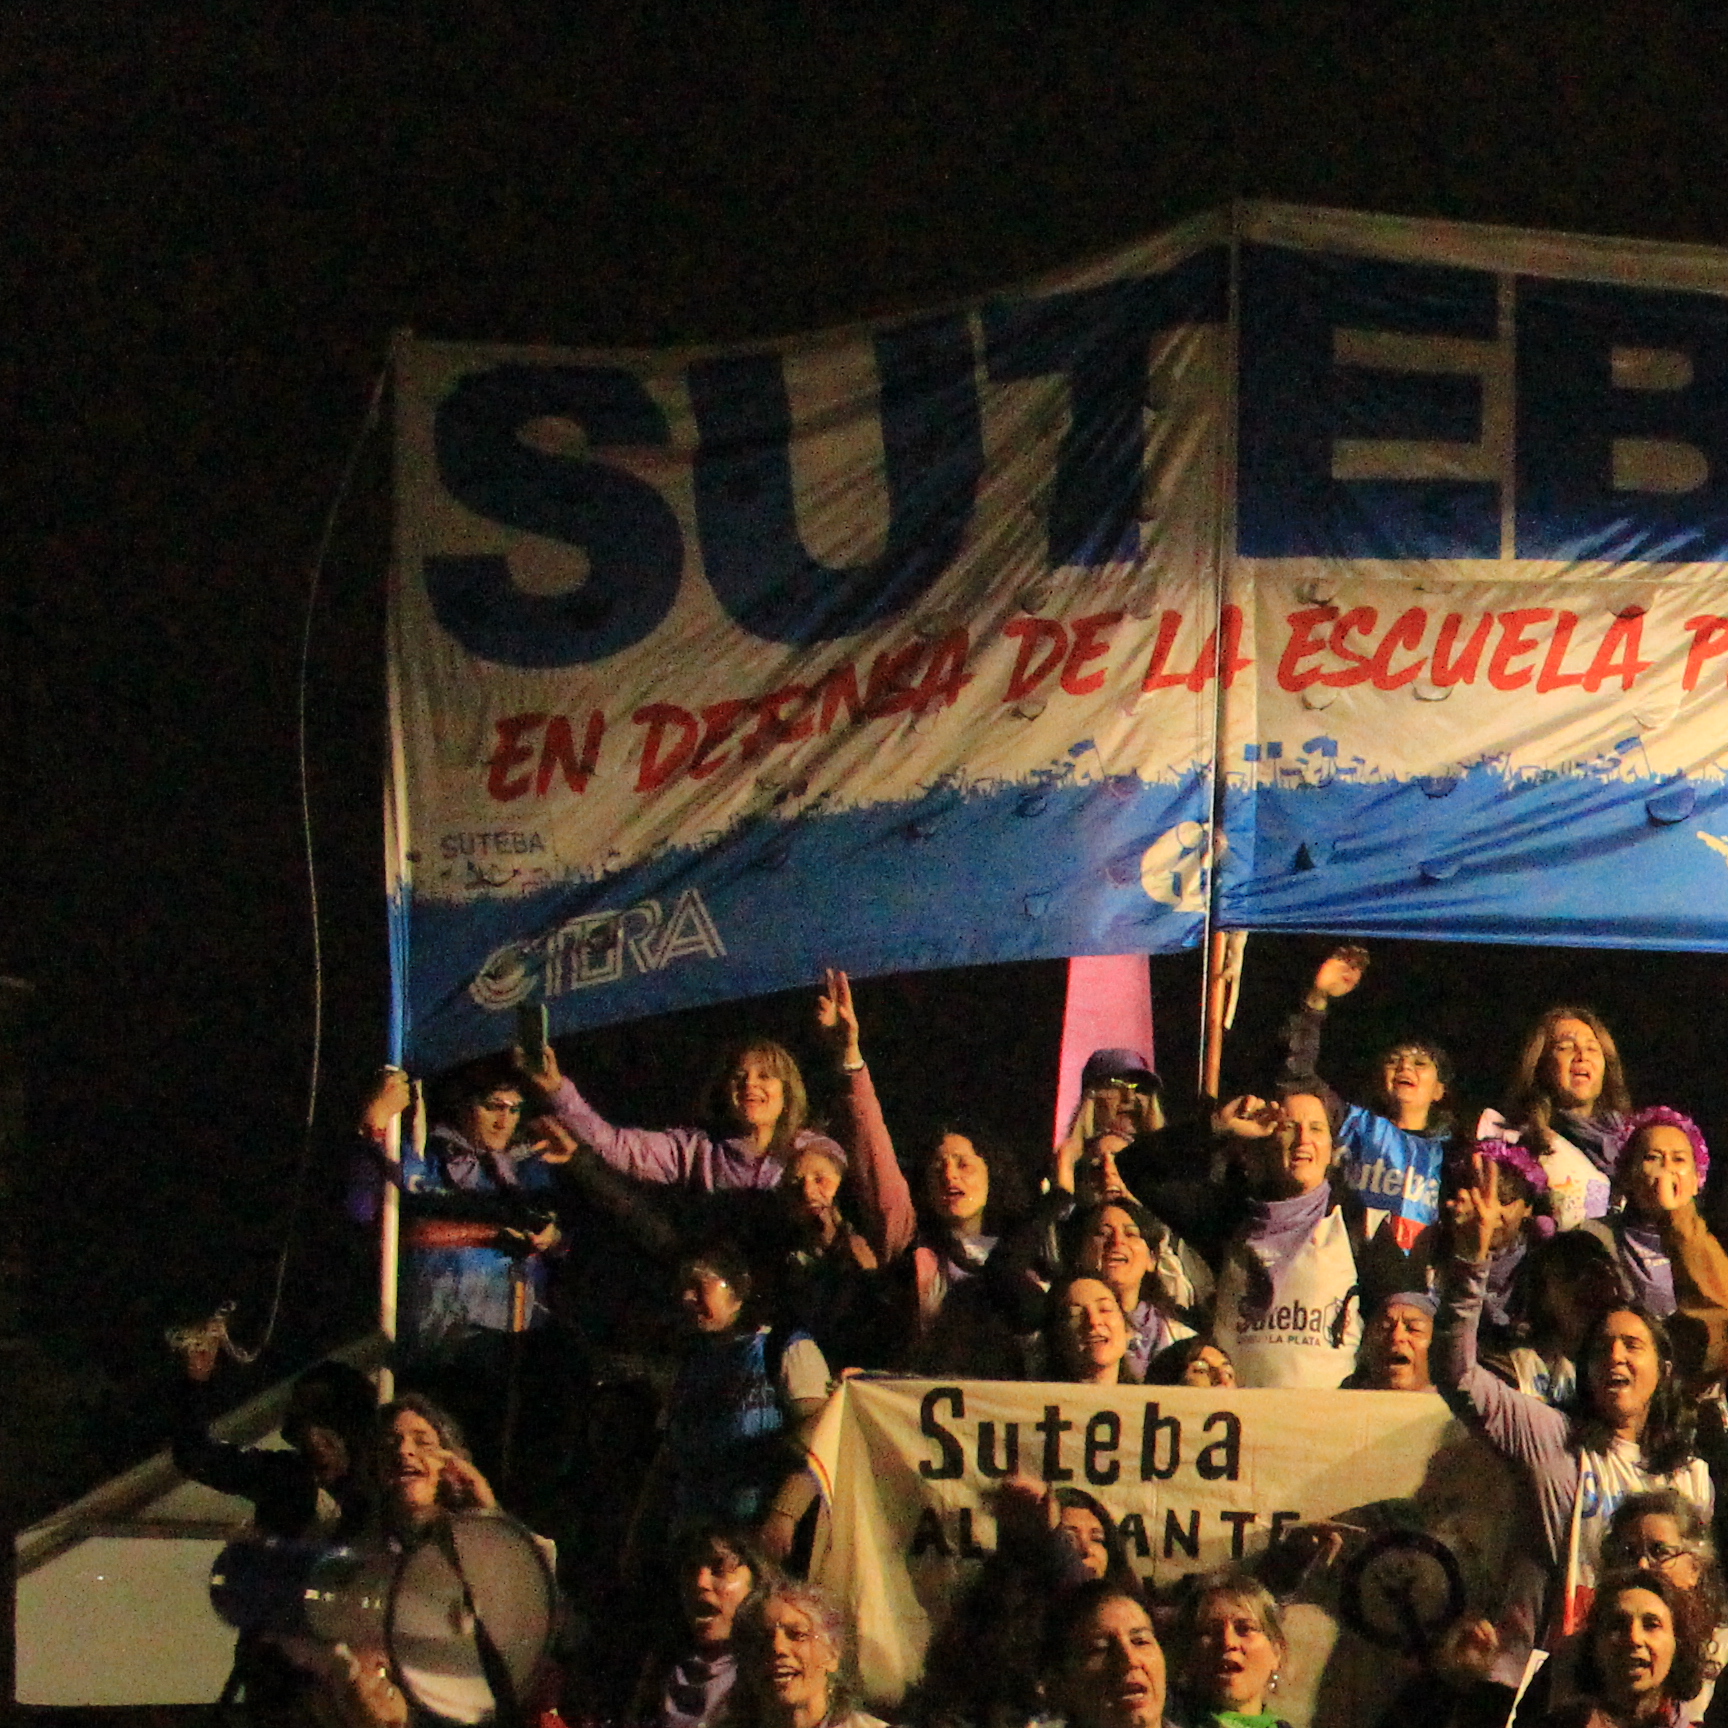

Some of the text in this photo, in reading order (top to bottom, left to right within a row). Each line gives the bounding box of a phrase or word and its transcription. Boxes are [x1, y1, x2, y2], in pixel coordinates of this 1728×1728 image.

[487, 710, 605, 800] EN
[1003, 609, 1127, 699] DE
[1141, 603, 1254, 693] LA
[1276, 604, 1653, 695] ESCUELA
[440, 831, 545, 859] SUTEBA
[1352, 1157, 1442, 1208] uteba
[919, 1386, 1243, 1486] Suteba
[909, 1506, 1301, 1562] ALANTE
